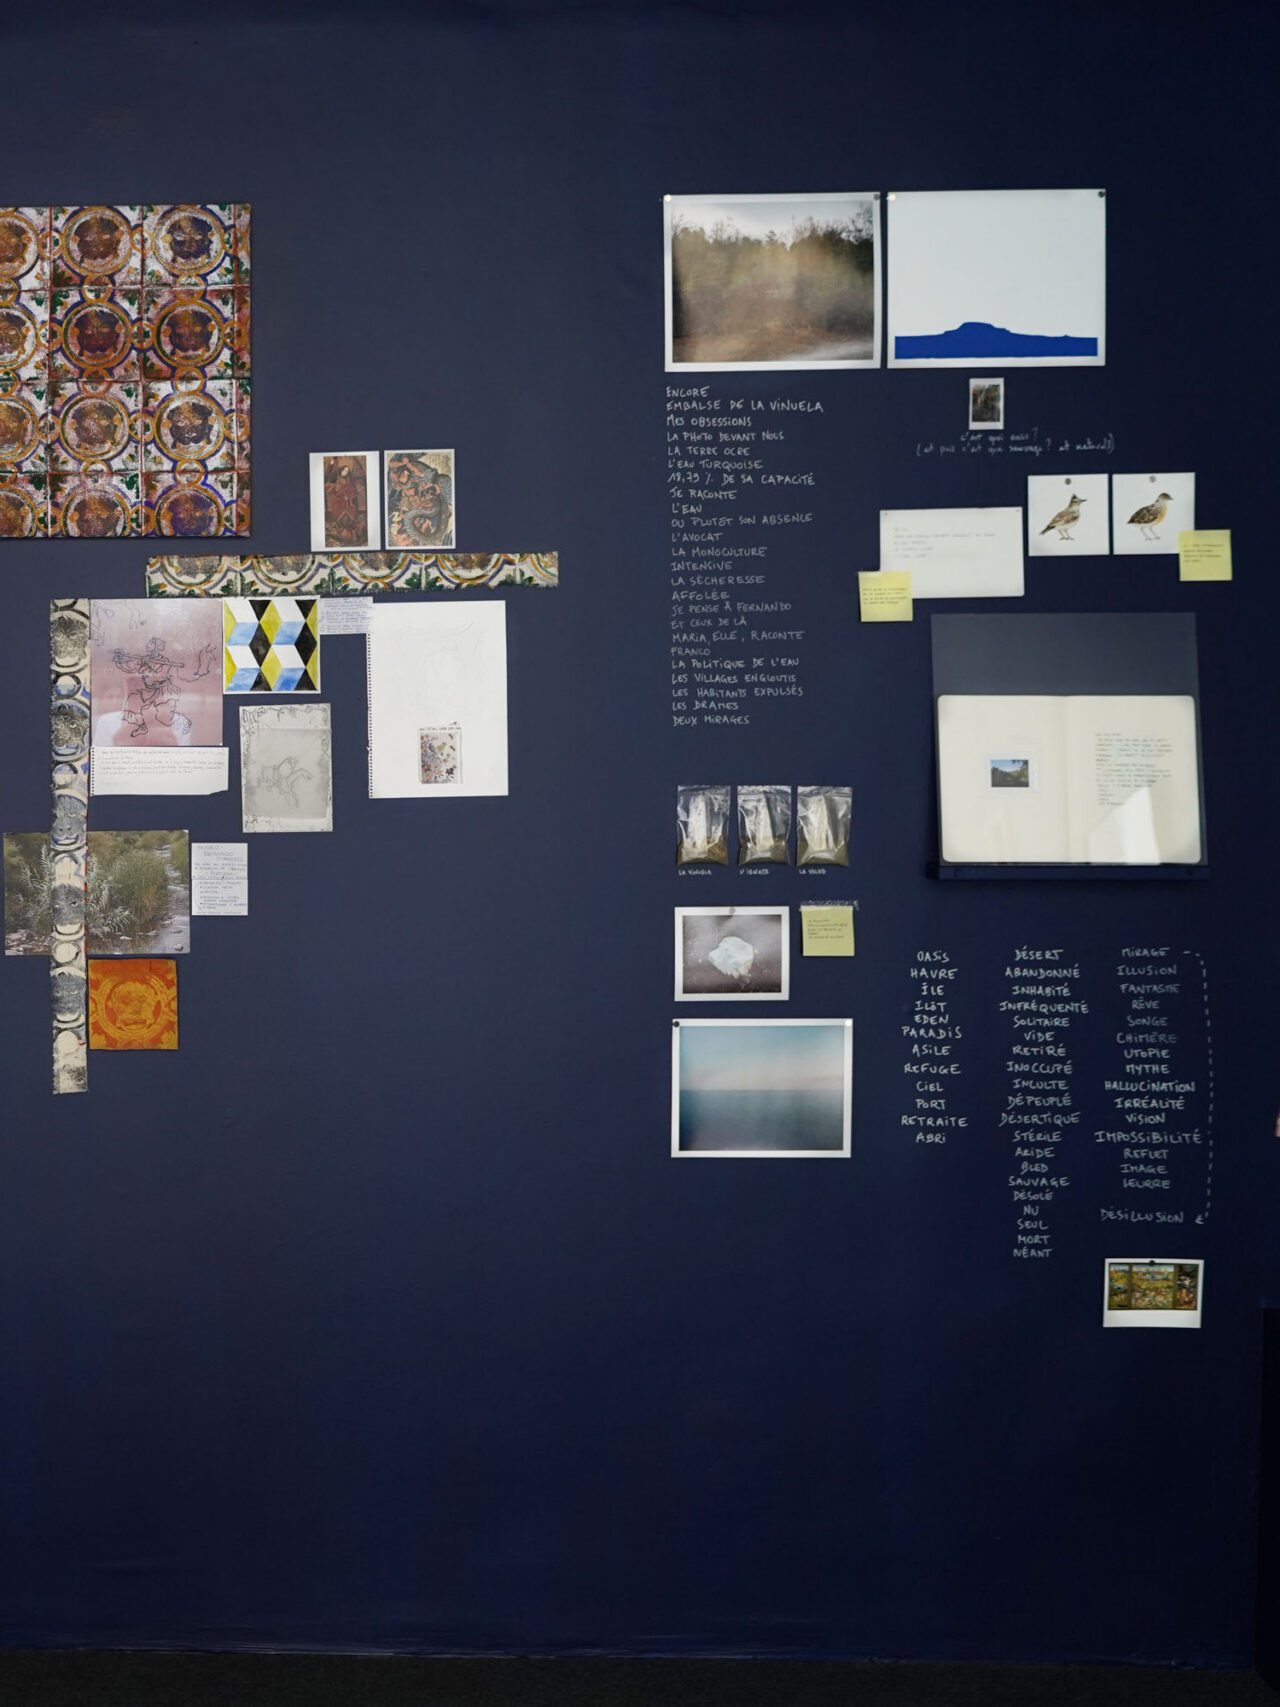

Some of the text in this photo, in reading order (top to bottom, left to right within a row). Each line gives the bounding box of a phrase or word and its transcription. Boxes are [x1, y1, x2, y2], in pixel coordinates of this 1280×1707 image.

[666, 386, 710, 398] ENCORE
[666, 400, 721, 411] EMBALSE
[730, 400, 744, 410] DE
[751, 400, 764, 411] LA
[666, 414, 752, 427] MES OBSESSIONS
[667, 431, 784, 442] LA PHOTO DEVANT NOUS
[668, 446, 750, 456] LA TERRE OCRE
[669, 460, 763, 471] L'EAU TURQUOISE
[721, 474, 735, 486] DE
[741, 475, 754, 484] SA
[761, 473, 816, 485] CAPACITÉ
[670, 486, 738, 499] JE RACONTE
[672, 503, 702, 514] L'EAU
[672, 518, 684, 528] OU
[739, 516, 756, 525] SON
[762, 513, 813, 525] ABSENCE
[672, 532, 723, 542] L'AVOCAT
[672, 547, 767, 557] LA MONOCULTURE
[671, 561, 733, 571] INTENSIVE
[671, 577, 685, 585] LA
[672, 589, 730, 601] AFFOLÉE
[671, 605, 684, 617] JE
[689, 604, 719, 613] PENSE
[737, 601, 791, 612] FERNANDO
[671, 621, 684, 629] ET
[690, 618, 713, 627] CEUX
[718, 618, 729, 626] DE
[751, 631, 805, 641] RACONTE
[671, 647, 711, 656] FRANCO
[672, 657, 799, 670] LA POLITIQUE DE L'EAU
[671, 673, 796, 685] LES VILLAGES ENGLOUTIS
[672, 684, 803, 698] LES HABITANTS EXPULSÉS
[672, 701, 739, 711] LES DRAMES
[673, 715, 750, 727] DEUX MIRAGES
[917, 950, 950, 963] OASIS
[1014, 946, 1064, 961] DÉSERT
[1121, 947, 1170, 958] MIRAGE
[910, 968, 958, 980] HAVRE
[1005, 963, 1081, 979] ABANDONNÉ
[1116, 964, 1178, 976] ILLUSION
[1011, 983, 1071, 997] INHABITÉ
[1120, 983, 1181, 995] FANTASME
[999, 999, 1089, 1015] INFRÉQUENTÉ
[914, 1014, 949, 1026] EDEN
[1013, 1015, 1070, 1028] SOLITAIRE
[1126, 1014, 1168, 1027] SONGE
[901, 1026, 963, 1039] PARADIS
[1023, 1031, 1055, 1042] VIDE
[912, 1044, 952, 1057] ASILE
[1012, 1044, 1067, 1057] RETIRÉ
[1123, 1049, 1170, 1059] UTOPIE
[904, 1062, 962, 1075] REFUGE
[1006, 1060, 1073, 1074] INOCCUPÉ
[1125, 1063, 1171, 1074] MYTHE
[916, 1081, 945, 1093] CIEL
[1012, 1078, 1069, 1090] INCULTE
[1104, 1080, 1196, 1093] HALLUCINATION
[915, 1098, 947, 1110] PORT
[1007, 1093, 1072, 1110] DÉPEUPLÉ
[1114, 1094, 1185, 1110] IRRÉALITÉ
[901, 1114, 969, 1127] RETRAITE
[999, 1111, 1081, 1127] DÉSERTIQUE
[1125, 1112, 1166, 1125] VISION
[916, 1132, 947, 1144] ABRI
[1012, 1129, 1063, 1143] STÉRILE
[1094, 1129, 1203, 1144] IMPOSSIBILITÉ
[1015, 1146, 1056, 1158] ARIDE
[1123, 1148, 1169, 1160] REFLET
[1021, 1162, 1049, 1174] BLED
[1120, 1163, 1168, 1174] IMAGE
[1008, 1175, 1070, 1188] SAUVAGE
[1123, 1178, 1171, 1189] LEURRE
[1013, 1188, 1054, 1202] DÉSOLÉ
[1023, 1205, 1039, 1216] NU
[1100, 1206, 1184, 1224] DÉSILLUSION
[1017, 1219, 1048, 1231] SEUL
[1017, 1234, 1051, 1246] MORT
[1013, 1245, 1053, 1258] NÉANT
